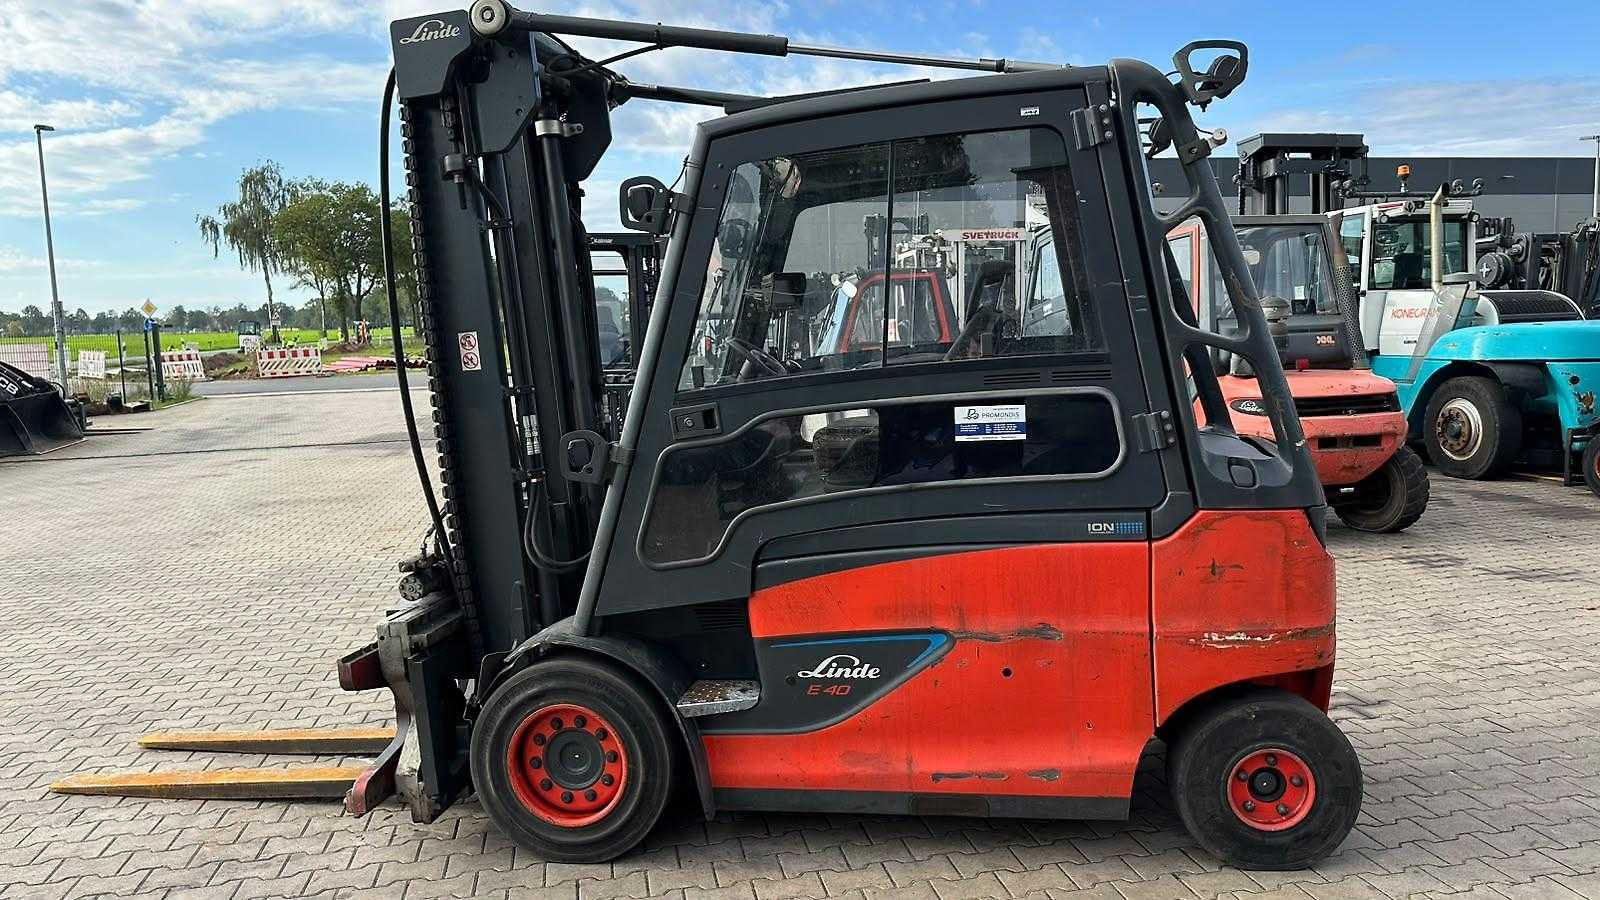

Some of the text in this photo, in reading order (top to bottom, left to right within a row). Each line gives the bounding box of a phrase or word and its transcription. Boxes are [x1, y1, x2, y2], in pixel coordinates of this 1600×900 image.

[400, 19, 460, 44] Linde
[962, 230, 1019, 240] SVETRUCK
[0, 376, 19, 395] CB
[981, 411, 1020, 419] PROMONDIS
[1087, 523, 1114, 532] ION
[797, 654, 881, 679] Linde
